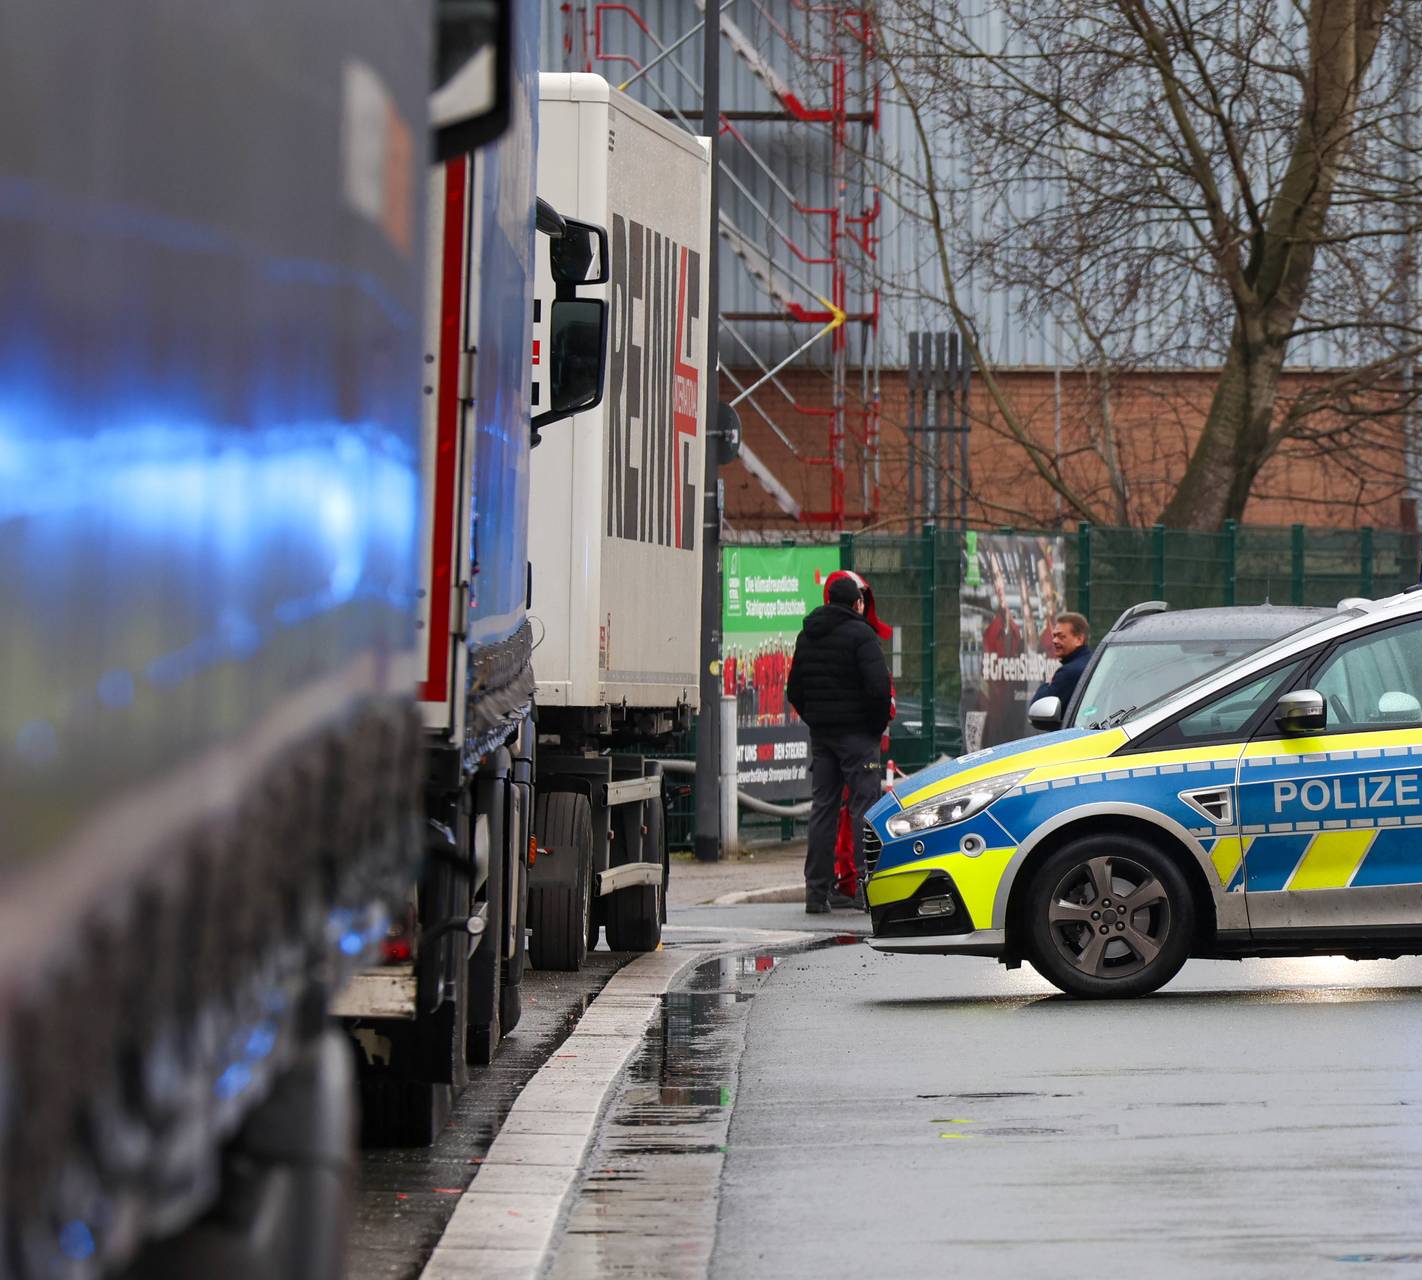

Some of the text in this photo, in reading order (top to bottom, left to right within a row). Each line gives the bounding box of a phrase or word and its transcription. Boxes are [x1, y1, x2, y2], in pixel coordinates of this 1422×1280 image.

[607, 213, 700, 551] REINKE
[745, 744, 757, 762] UNS
[774, 742, 785, 760] DEN
